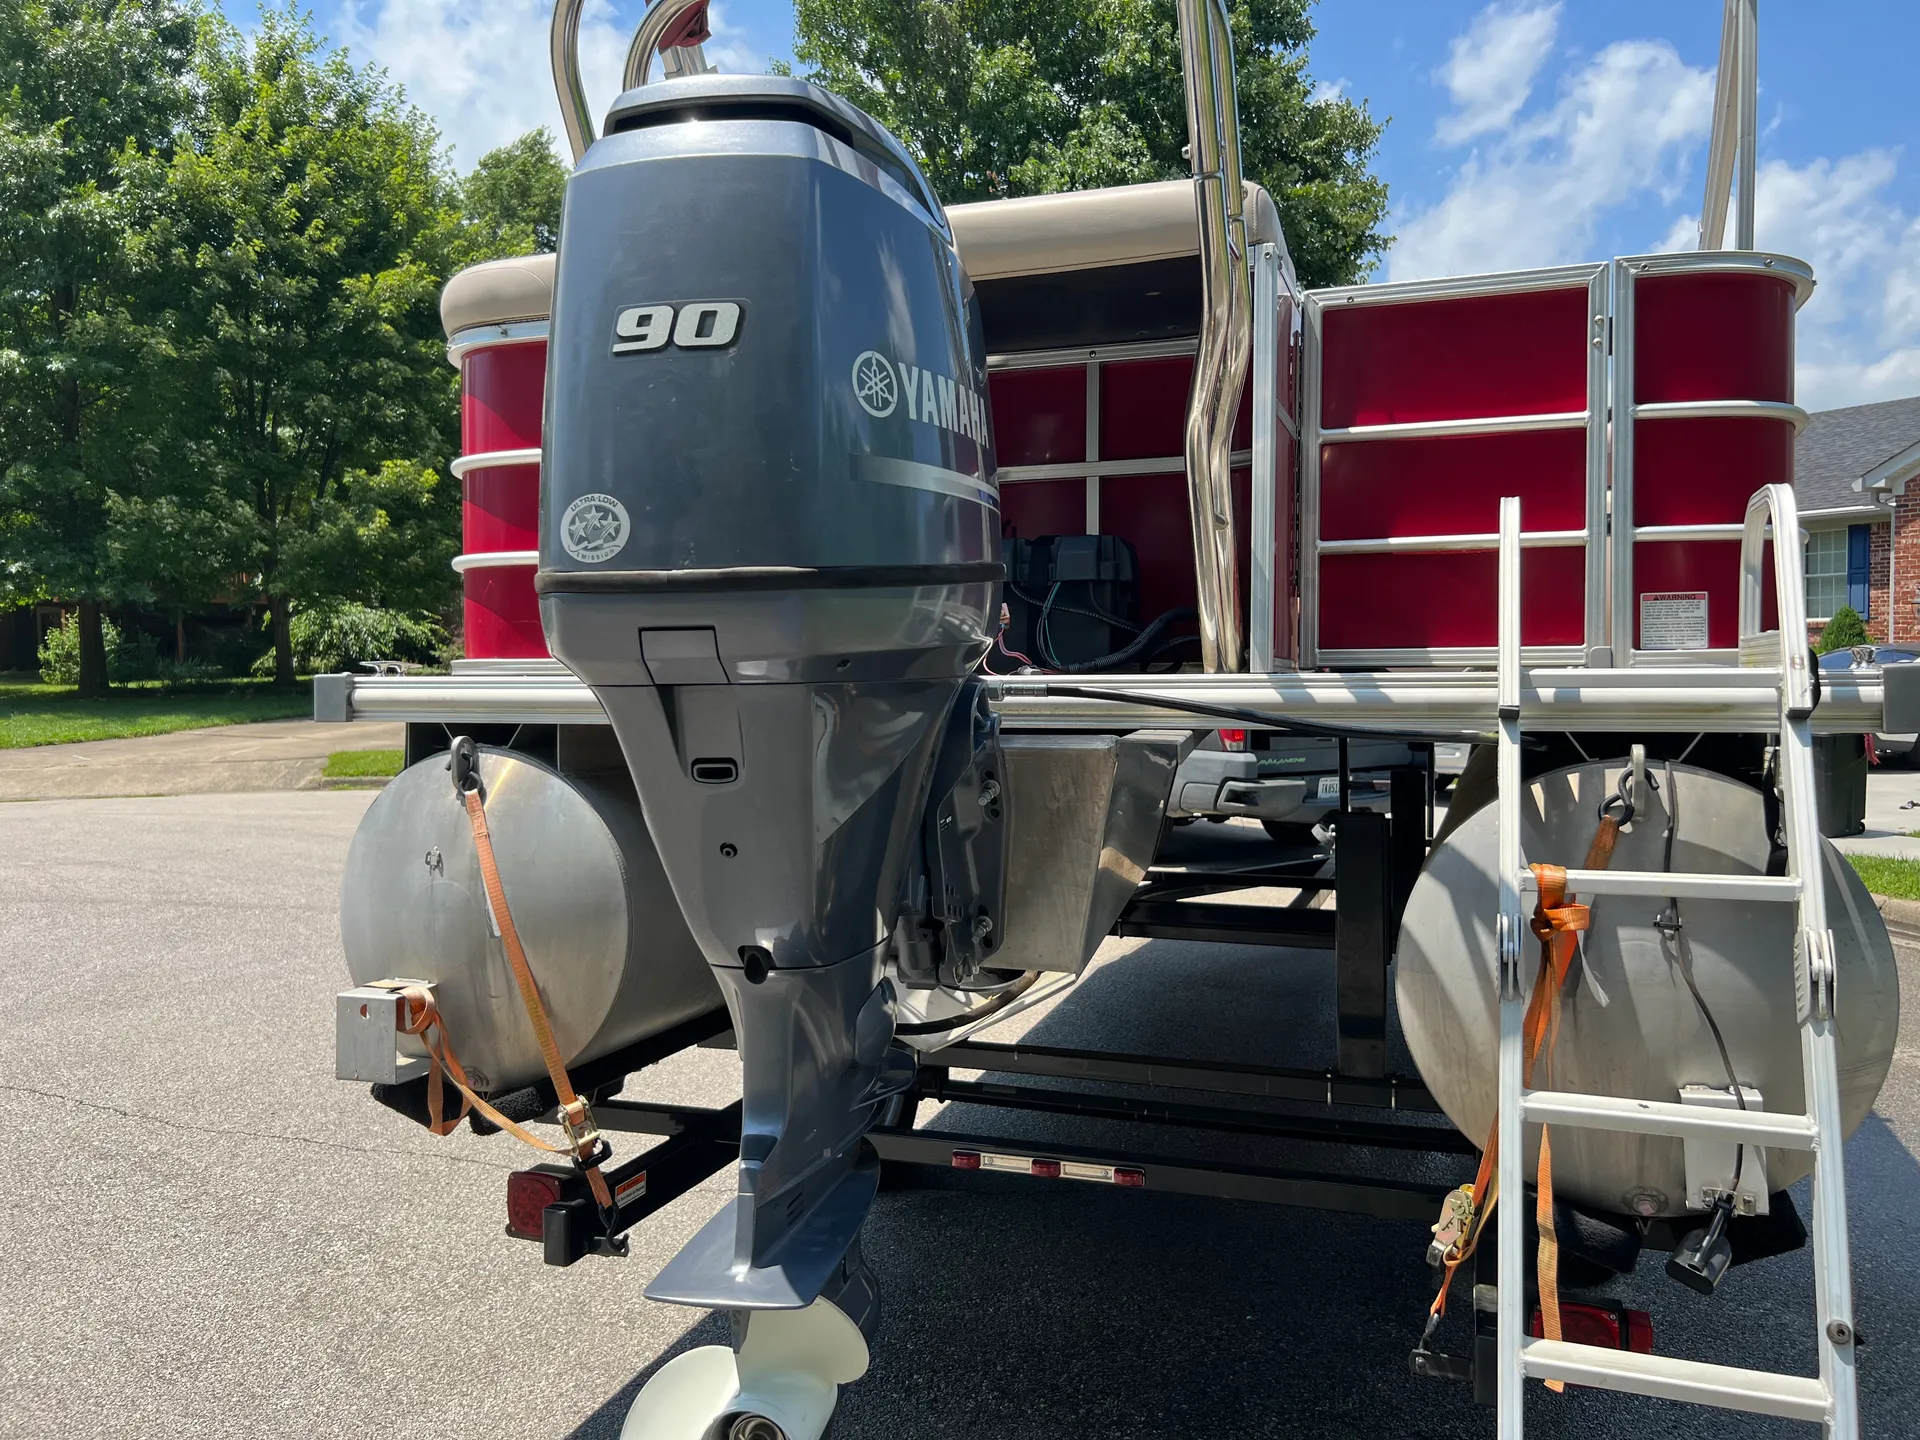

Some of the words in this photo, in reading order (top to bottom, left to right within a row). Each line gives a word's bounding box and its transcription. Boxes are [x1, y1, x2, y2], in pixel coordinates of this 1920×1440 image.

[612, 302, 740, 353] 90
[898, 362, 989, 449] YAMAHA
[576, 548, 615, 561] EMISSION
[1256, 757, 1307, 767] AVALANCHE
